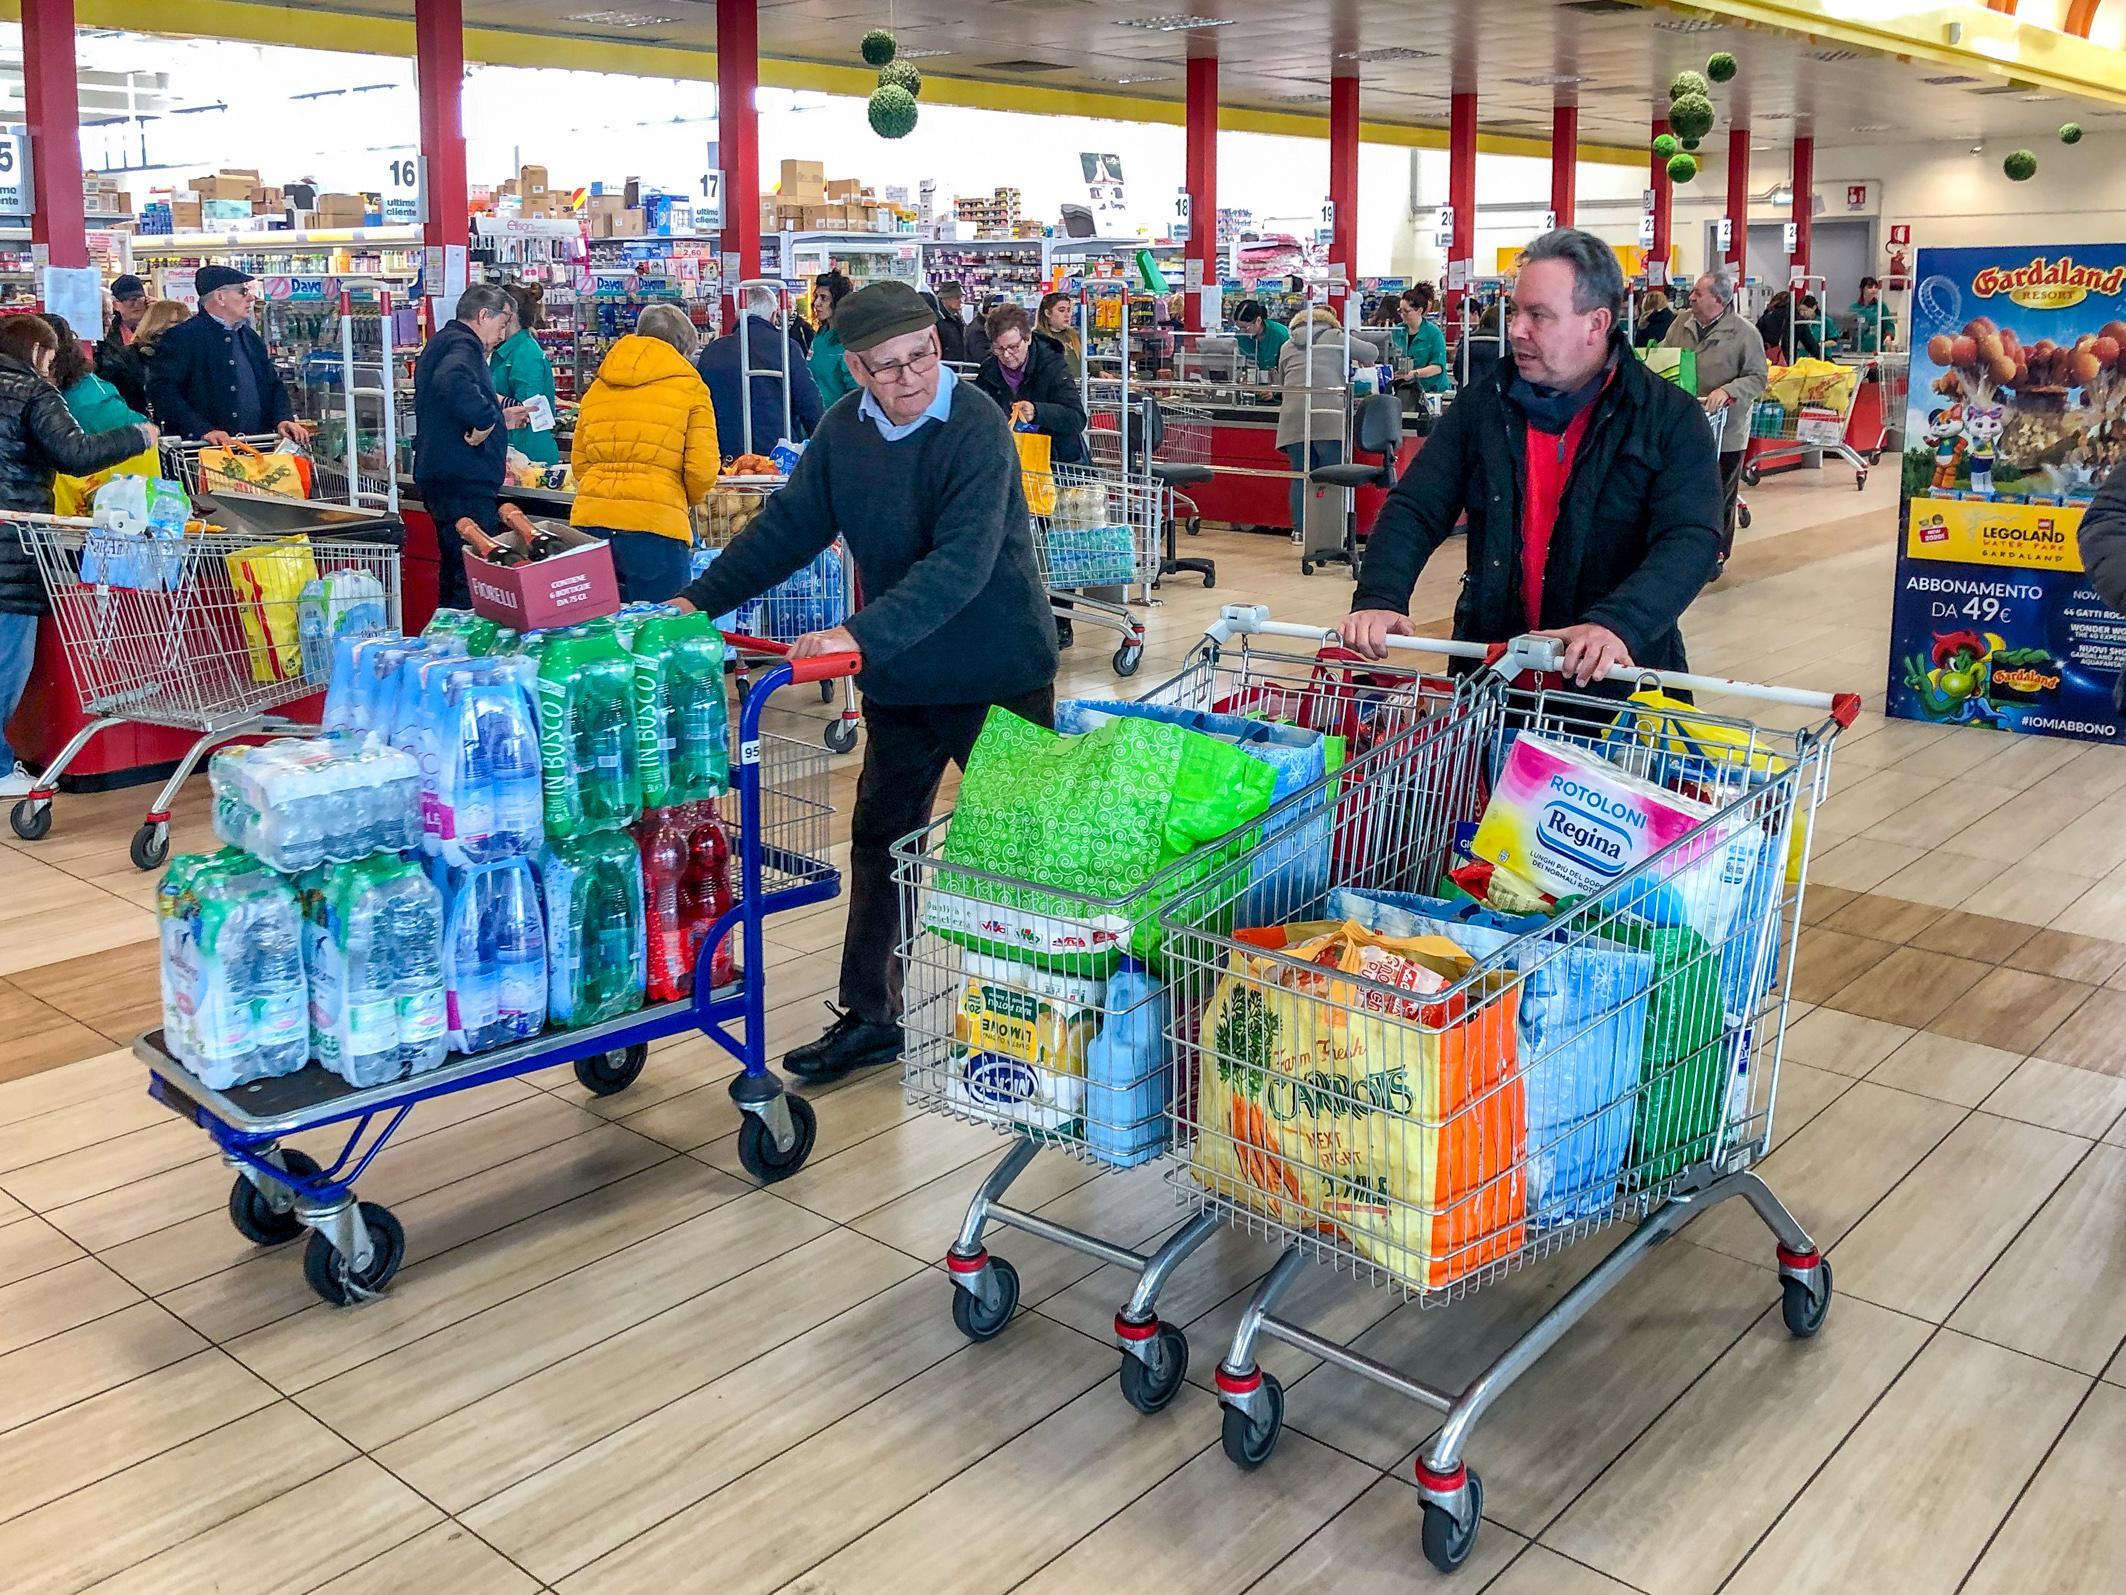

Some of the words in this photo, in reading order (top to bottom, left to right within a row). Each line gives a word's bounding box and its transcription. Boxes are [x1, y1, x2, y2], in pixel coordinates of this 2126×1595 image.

[389, 160, 416, 187] 16
[700, 174, 718, 197] 17
[386, 208, 417, 217] cliente
[387, 199, 416, 207] ultimo
[696, 208, 719, 216] ultimo
[1175, 199, 1188, 216] 18
[1321, 206, 1332, 222] 19
[1972, 257, 2126, 298] Gardaland
[2022, 290, 2074, 300] RESORT
[1983, 519, 2064, 543] LEGOLAND
[1982, 550, 2064, 563] GARDALAND
[472, 578, 518, 608] FIORELLI
[1906, 577, 2042, 599] ABBONAMENTO
[2073, 590, 2100, 600] NOV
[1931, 602, 1958, 618] DA
[2076, 609, 2102, 618] GATTI
[2070, 624, 2110, 633] WONDER
[2079, 645, 2108, 654] NUOVI
[1992, 668, 2060, 689] Gardaland
[634, 675, 658, 742] BOSCO
[541, 701, 566, 769] BOSCO
[2021, 717, 2116, 736] #IOMIABBONO
[745, 745, 760, 758] 95
[1550, 774, 1648, 829] ROTOLONI
[1547, 808, 1622, 860] Regina
[1529, 850, 1555, 867] LUNGHI
[1556, 863, 1569, 873] PIÙ
[1569, 869, 1583, 880] DEL
[1532, 859, 1544, 869] DEI
[1544, 866, 1577, 886] NORMALI
[982, 1018, 1032, 1043] LIMONE
[1316, 1037, 1367, 1062] Fresh
[1268, 1064, 1417, 1121] CARROTS
[1306, 1132, 1342, 1149] NEXT
[1320, 1151, 1363, 1168] RIGHT
[1343, 1175, 1391, 1205] MILE
